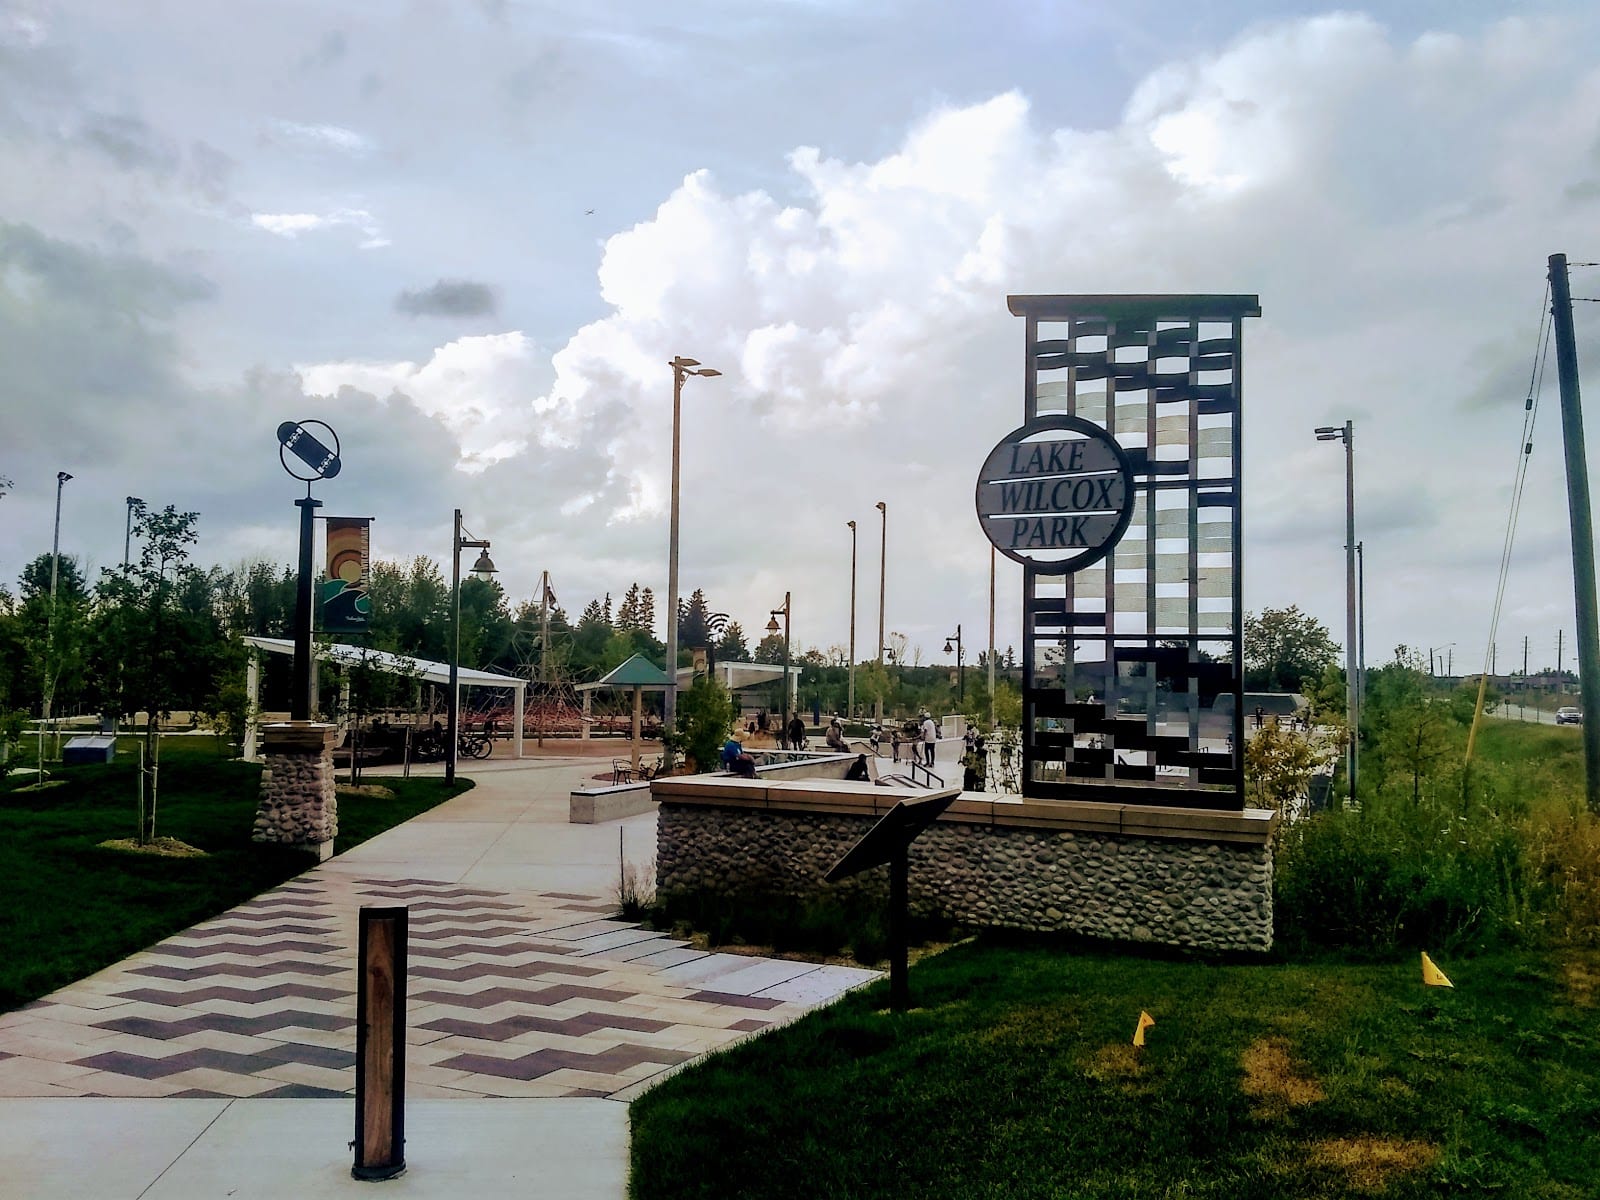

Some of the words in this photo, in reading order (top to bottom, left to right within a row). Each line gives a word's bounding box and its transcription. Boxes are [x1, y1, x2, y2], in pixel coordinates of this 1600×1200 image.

[1009, 441, 1086, 474] LAKE
[1001, 478, 1116, 512] WILCOX
[1010, 516, 1091, 548] PARK
